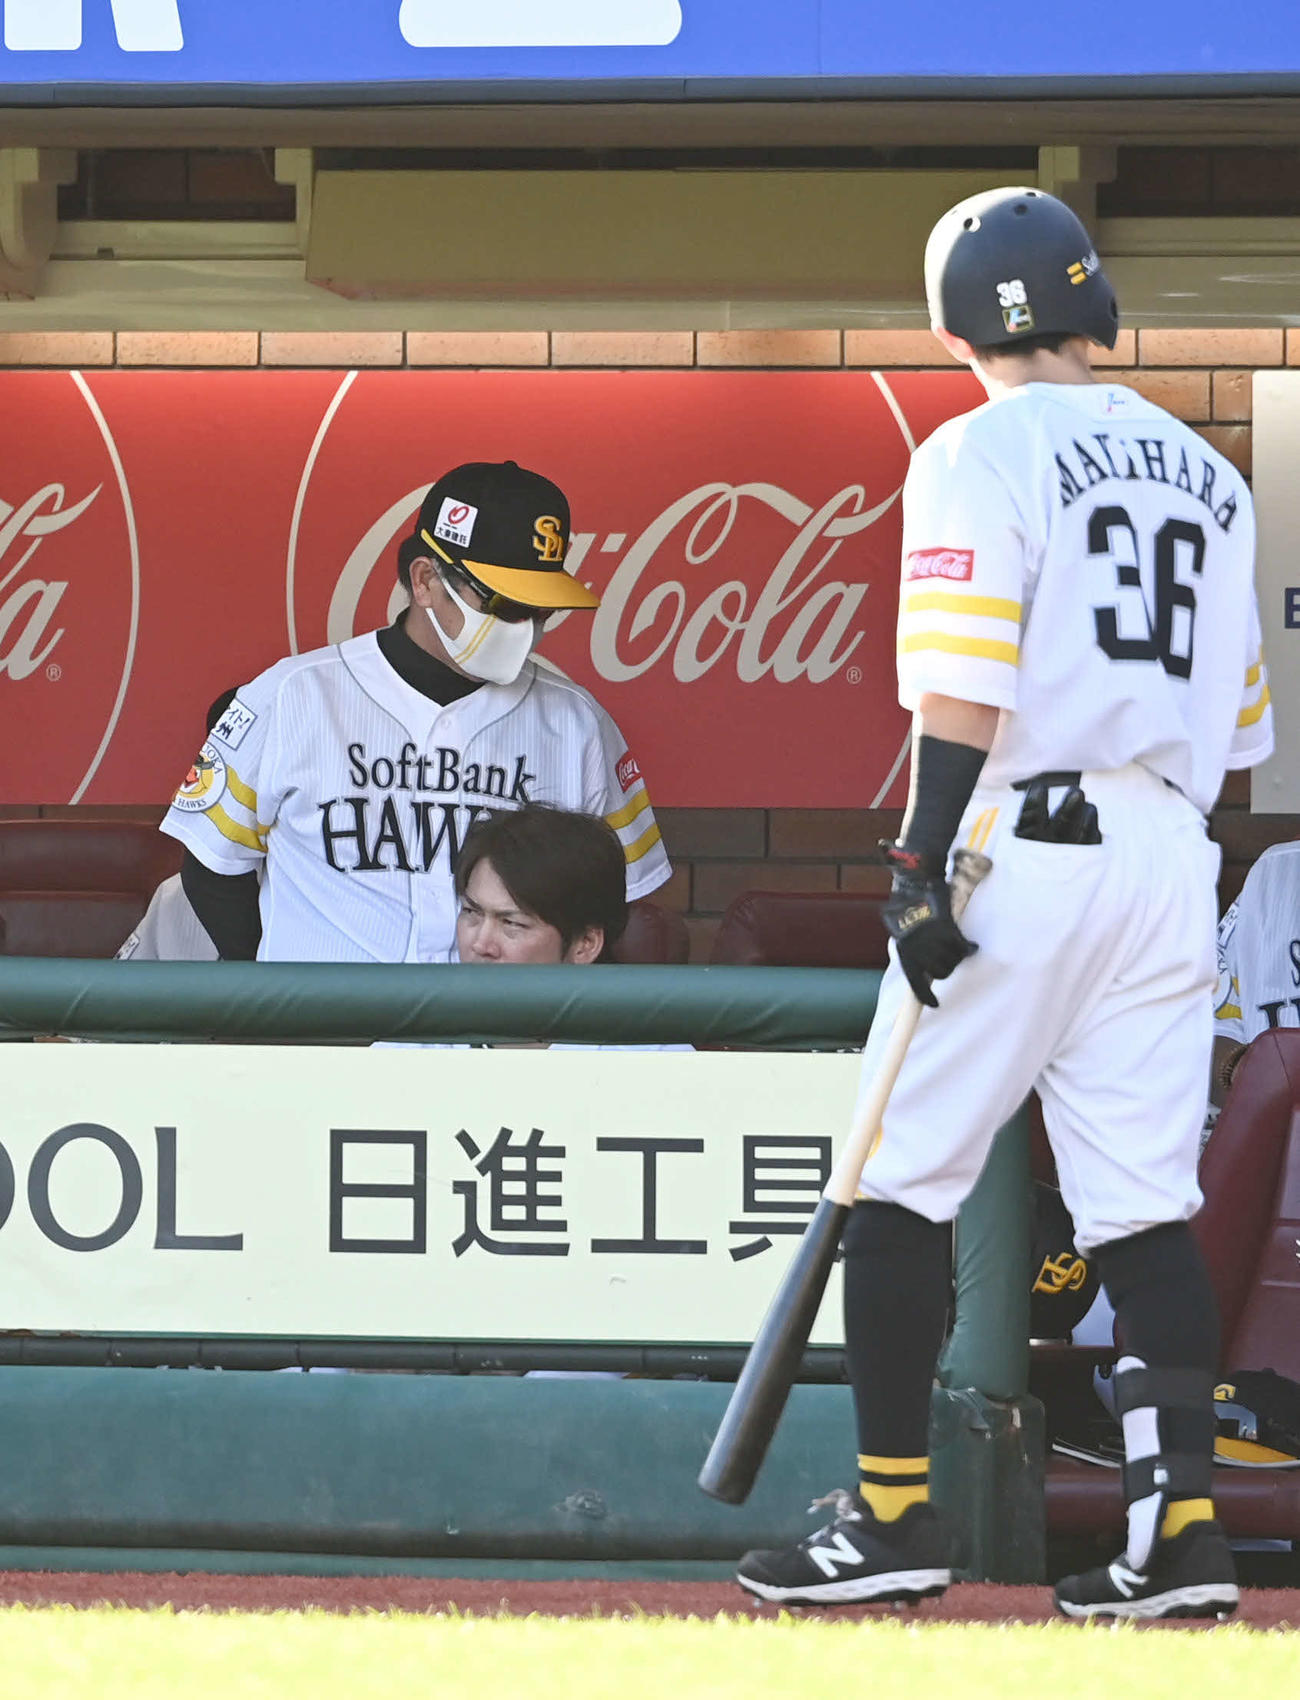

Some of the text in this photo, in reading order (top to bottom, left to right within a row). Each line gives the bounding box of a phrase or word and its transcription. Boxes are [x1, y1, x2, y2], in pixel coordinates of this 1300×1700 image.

[996, 279, 1028, 308] 36
[1087, 505, 1205, 680] 36
[347, 742, 537, 804] SoftBank
[318, 795, 498, 873] HAW
[0, 1122, 845, 1262] OL 日進工具
